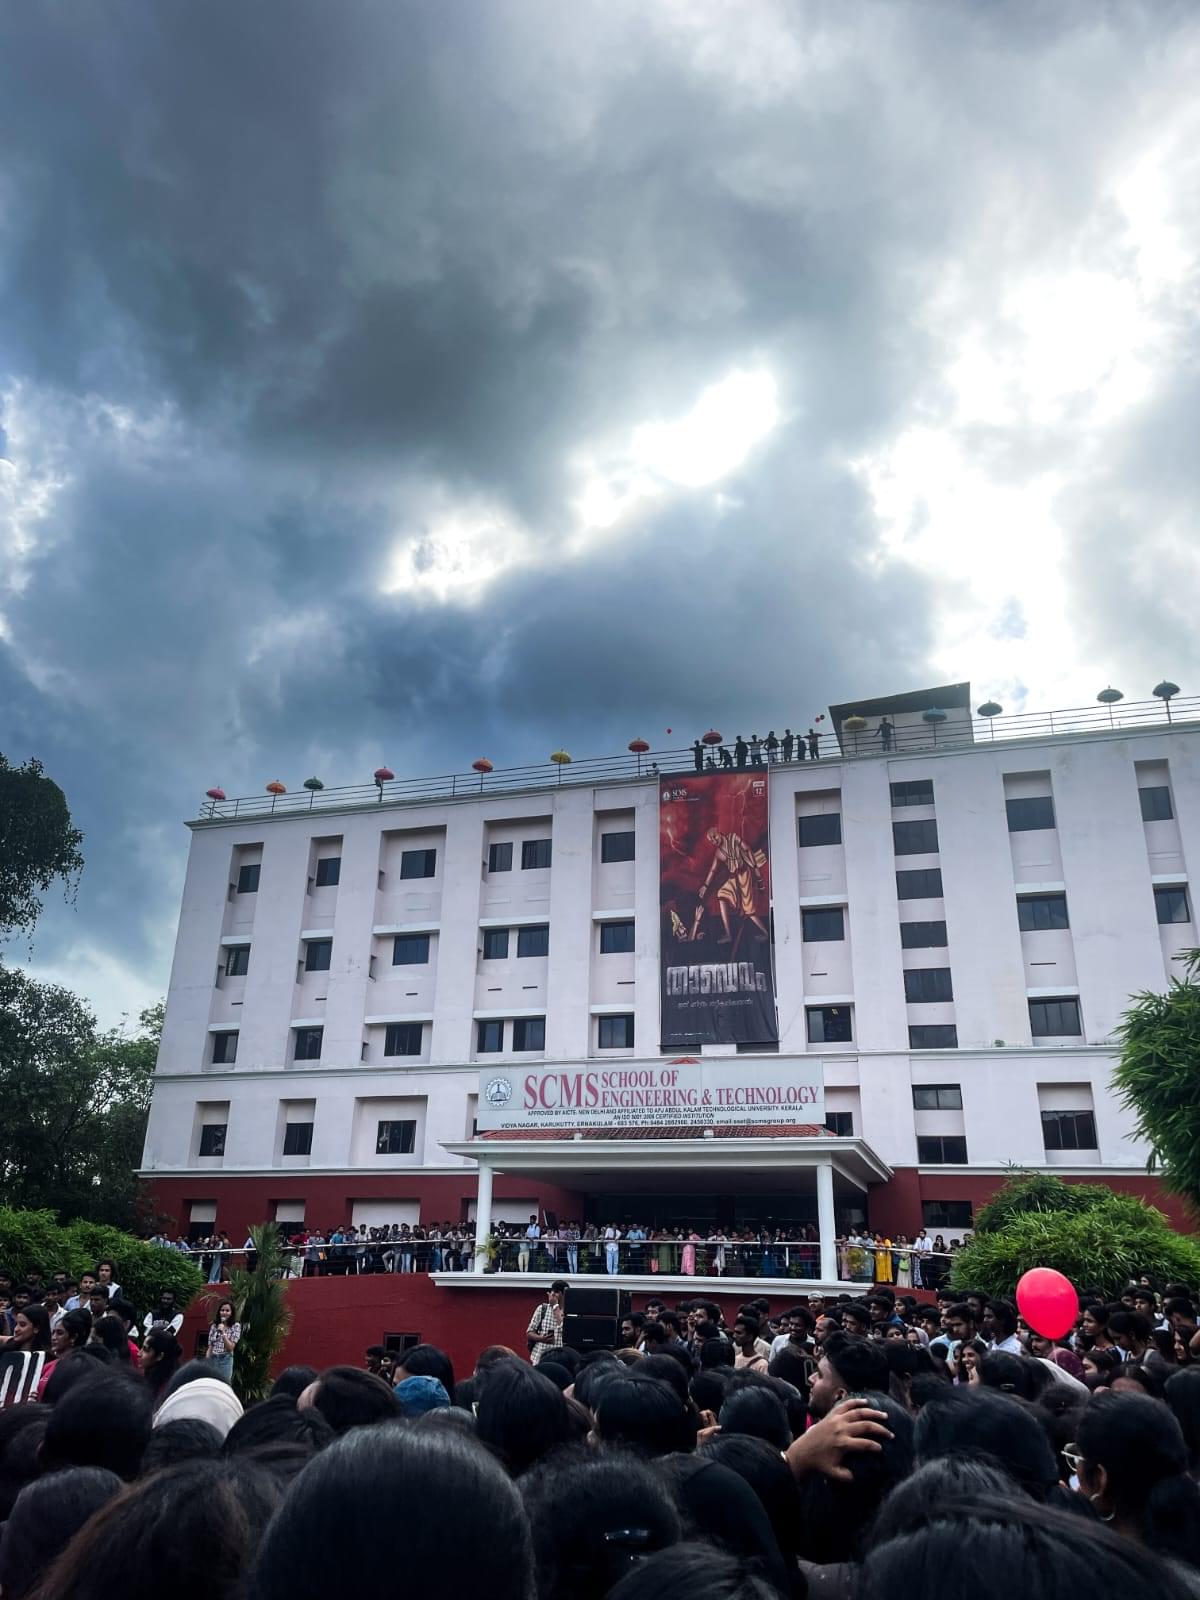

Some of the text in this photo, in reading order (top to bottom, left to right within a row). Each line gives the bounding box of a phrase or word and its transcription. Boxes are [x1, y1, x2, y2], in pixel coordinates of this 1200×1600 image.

[601, 1070, 680, 1088] SCHOOL OF
[524, 1072, 598, 1110] SCMS
[602, 1086, 819, 1107] ENGINEERING & TECHNOLOGY
